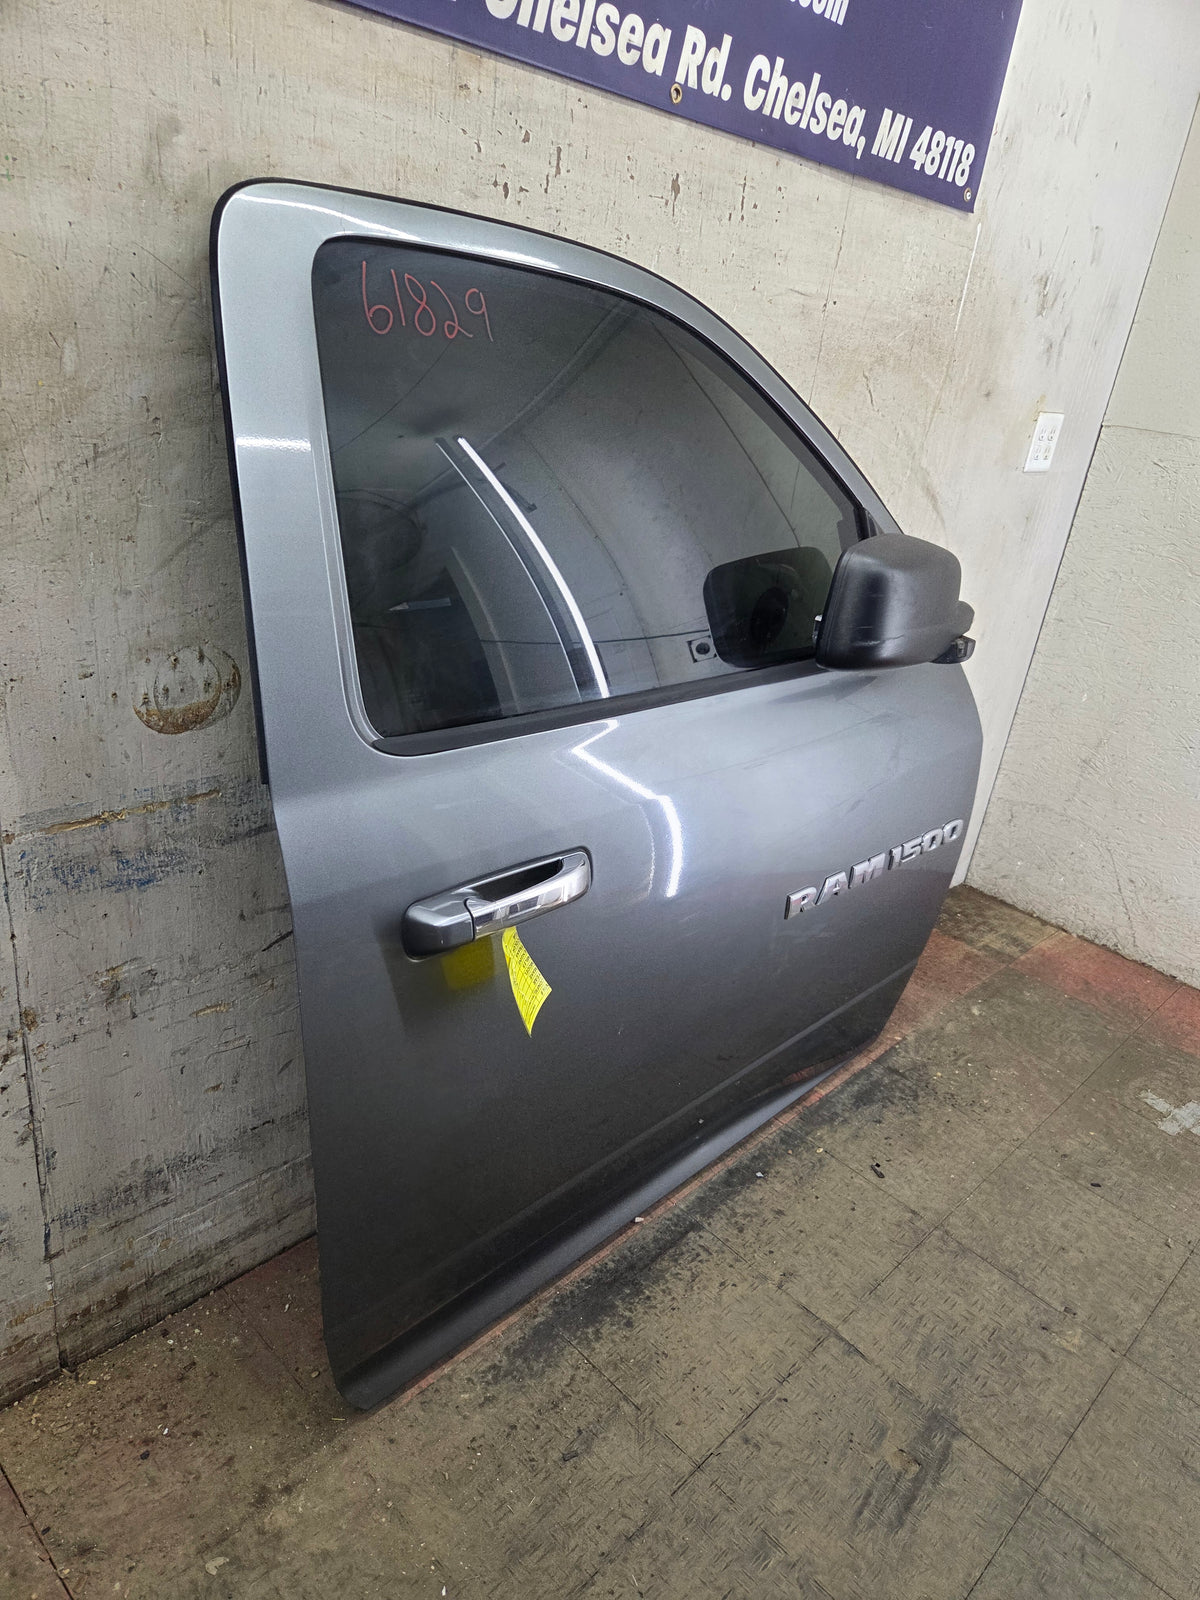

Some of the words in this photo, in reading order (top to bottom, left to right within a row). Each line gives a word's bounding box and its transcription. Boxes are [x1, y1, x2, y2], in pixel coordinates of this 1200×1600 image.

[485, 0, 671, 76] elsea
[675, 25, 733, 101] Rd.
[743, 55, 866, 159] Chelsea,
[871, 108, 914, 163] MI
[909, 126, 976, 187] 48118
[362, 261, 493, 342] 61829
[784, 852, 886, 920] RAM
[888, 818, 964, 870] 1500
